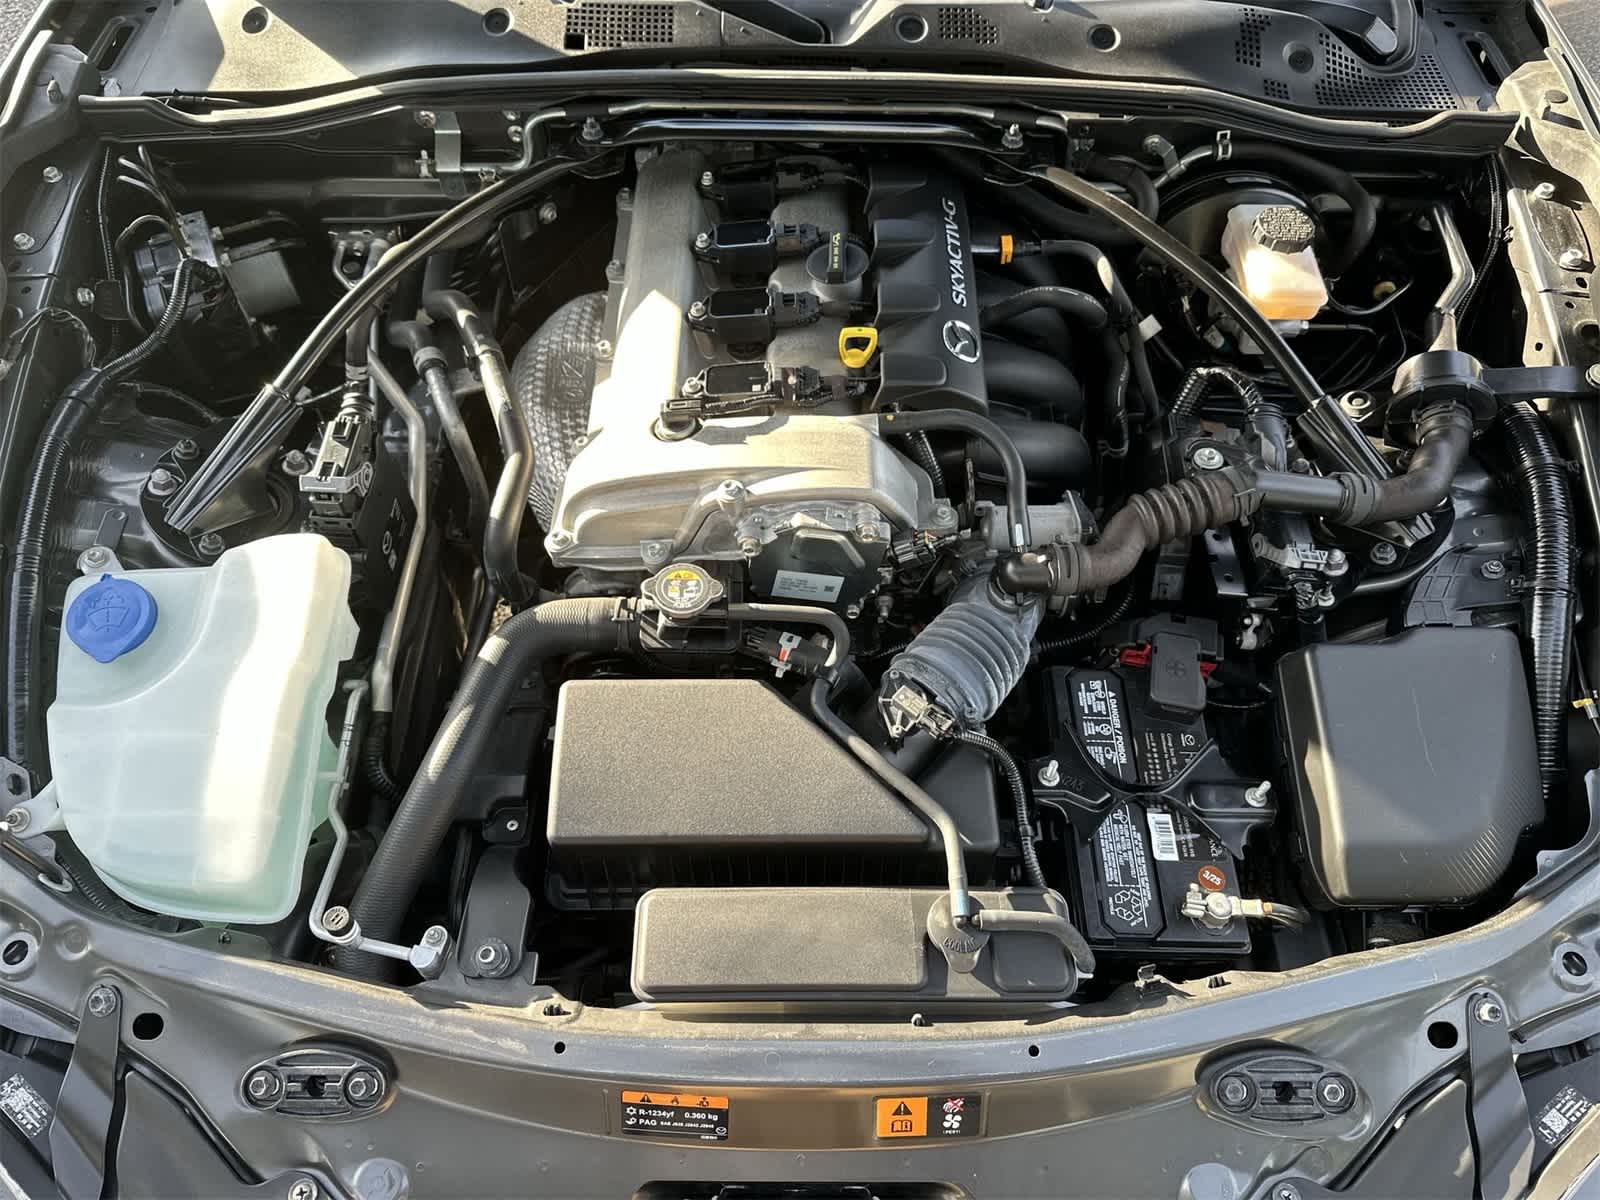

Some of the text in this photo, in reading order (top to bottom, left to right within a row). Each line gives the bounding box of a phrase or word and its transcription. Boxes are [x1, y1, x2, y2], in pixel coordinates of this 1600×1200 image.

[942, 197, 967, 308] SKYACTIV-G
[1109, 698, 1121, 729] DANGER
[1115, 735, 1127, 764] POISON
[1202, 870, 1222, 886] 3/25
[638, 1109, 675, 1119] R-1234yf
[708, 1113, 719, 1121] kg
[638, 1118, 657, 1126] PAG
